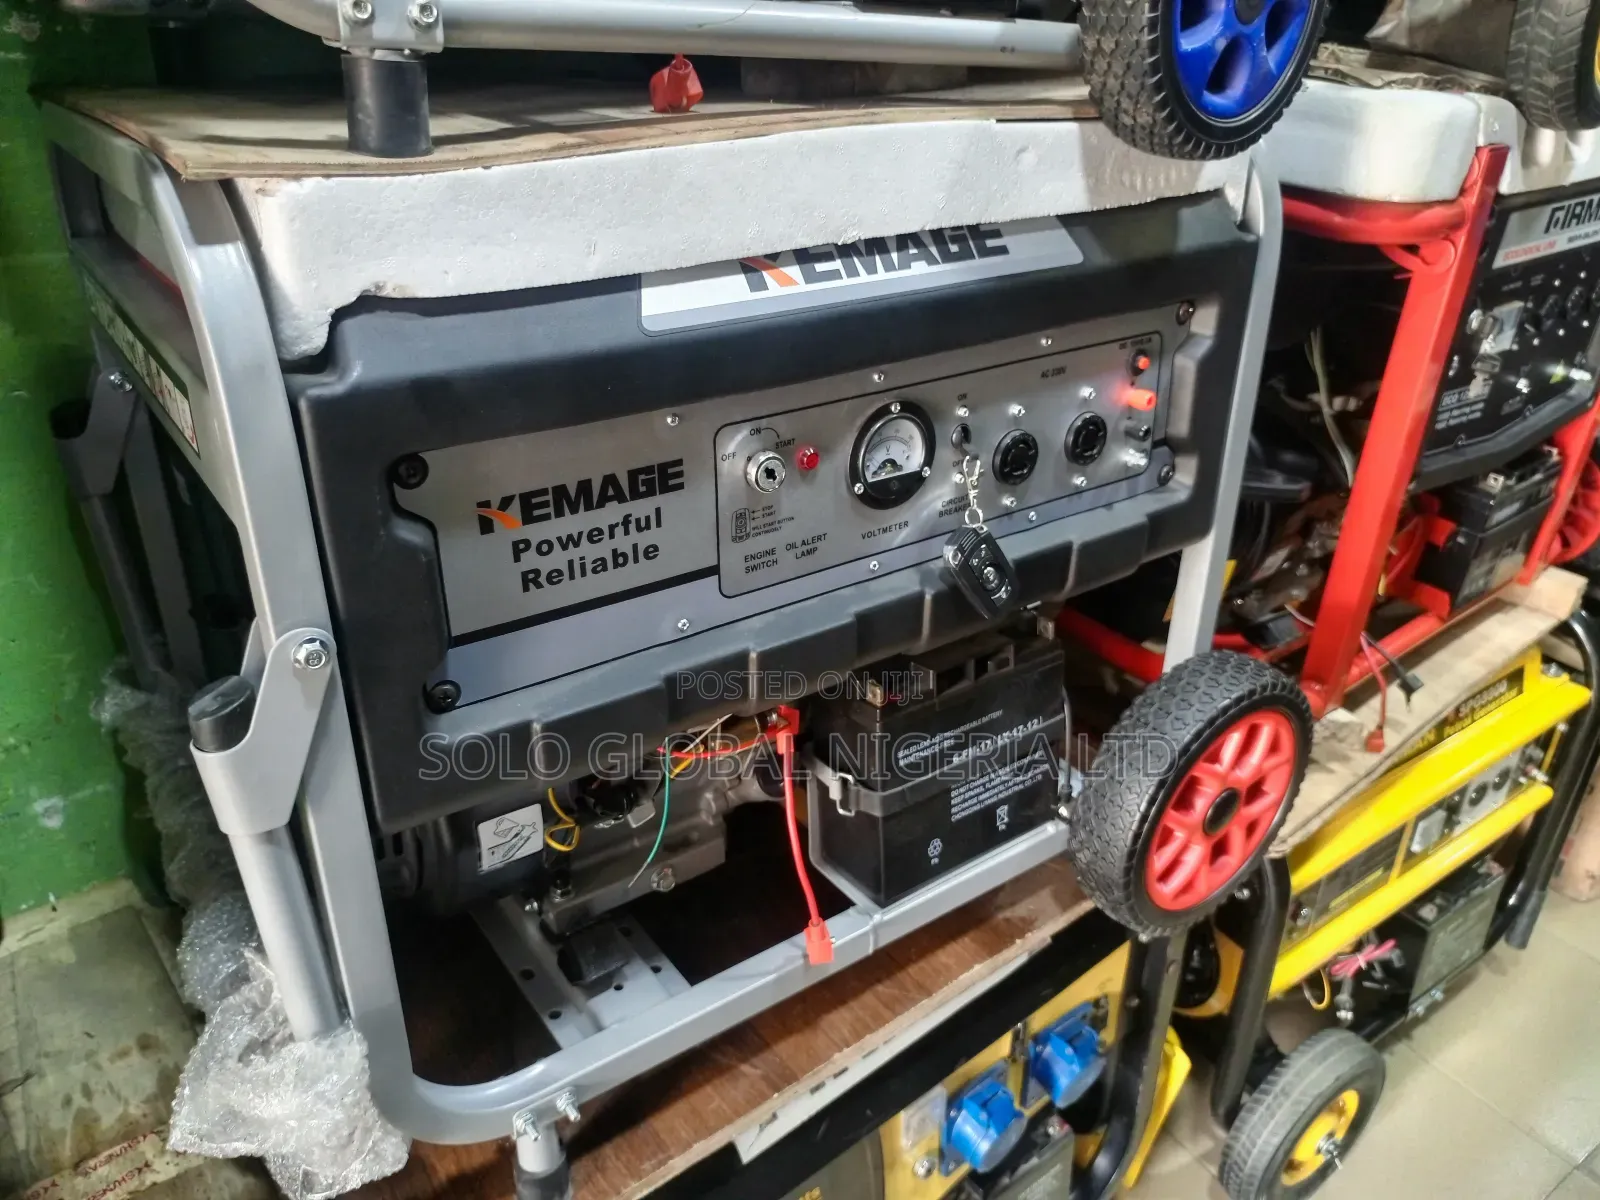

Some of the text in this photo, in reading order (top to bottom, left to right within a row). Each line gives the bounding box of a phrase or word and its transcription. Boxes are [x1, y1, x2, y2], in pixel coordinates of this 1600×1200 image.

[749, 427, 762, 436] ON
[775, 438, 796, 450] START
[721, 451, 737, 462] OFF
[474, 458, 685, 536] KEMAGE
[511, 506, 663, 563] Powerful
[861, 520, 909, 541] VOLTMETER
[785, 533, 828, 552] OIL ALERT
[744, 547, 777, 563] ENGINE
[795, 546, 818, 560] LAMP
[520, 542, 660, 593] Reliable
[744, 557, 778, 574] SWITCH
